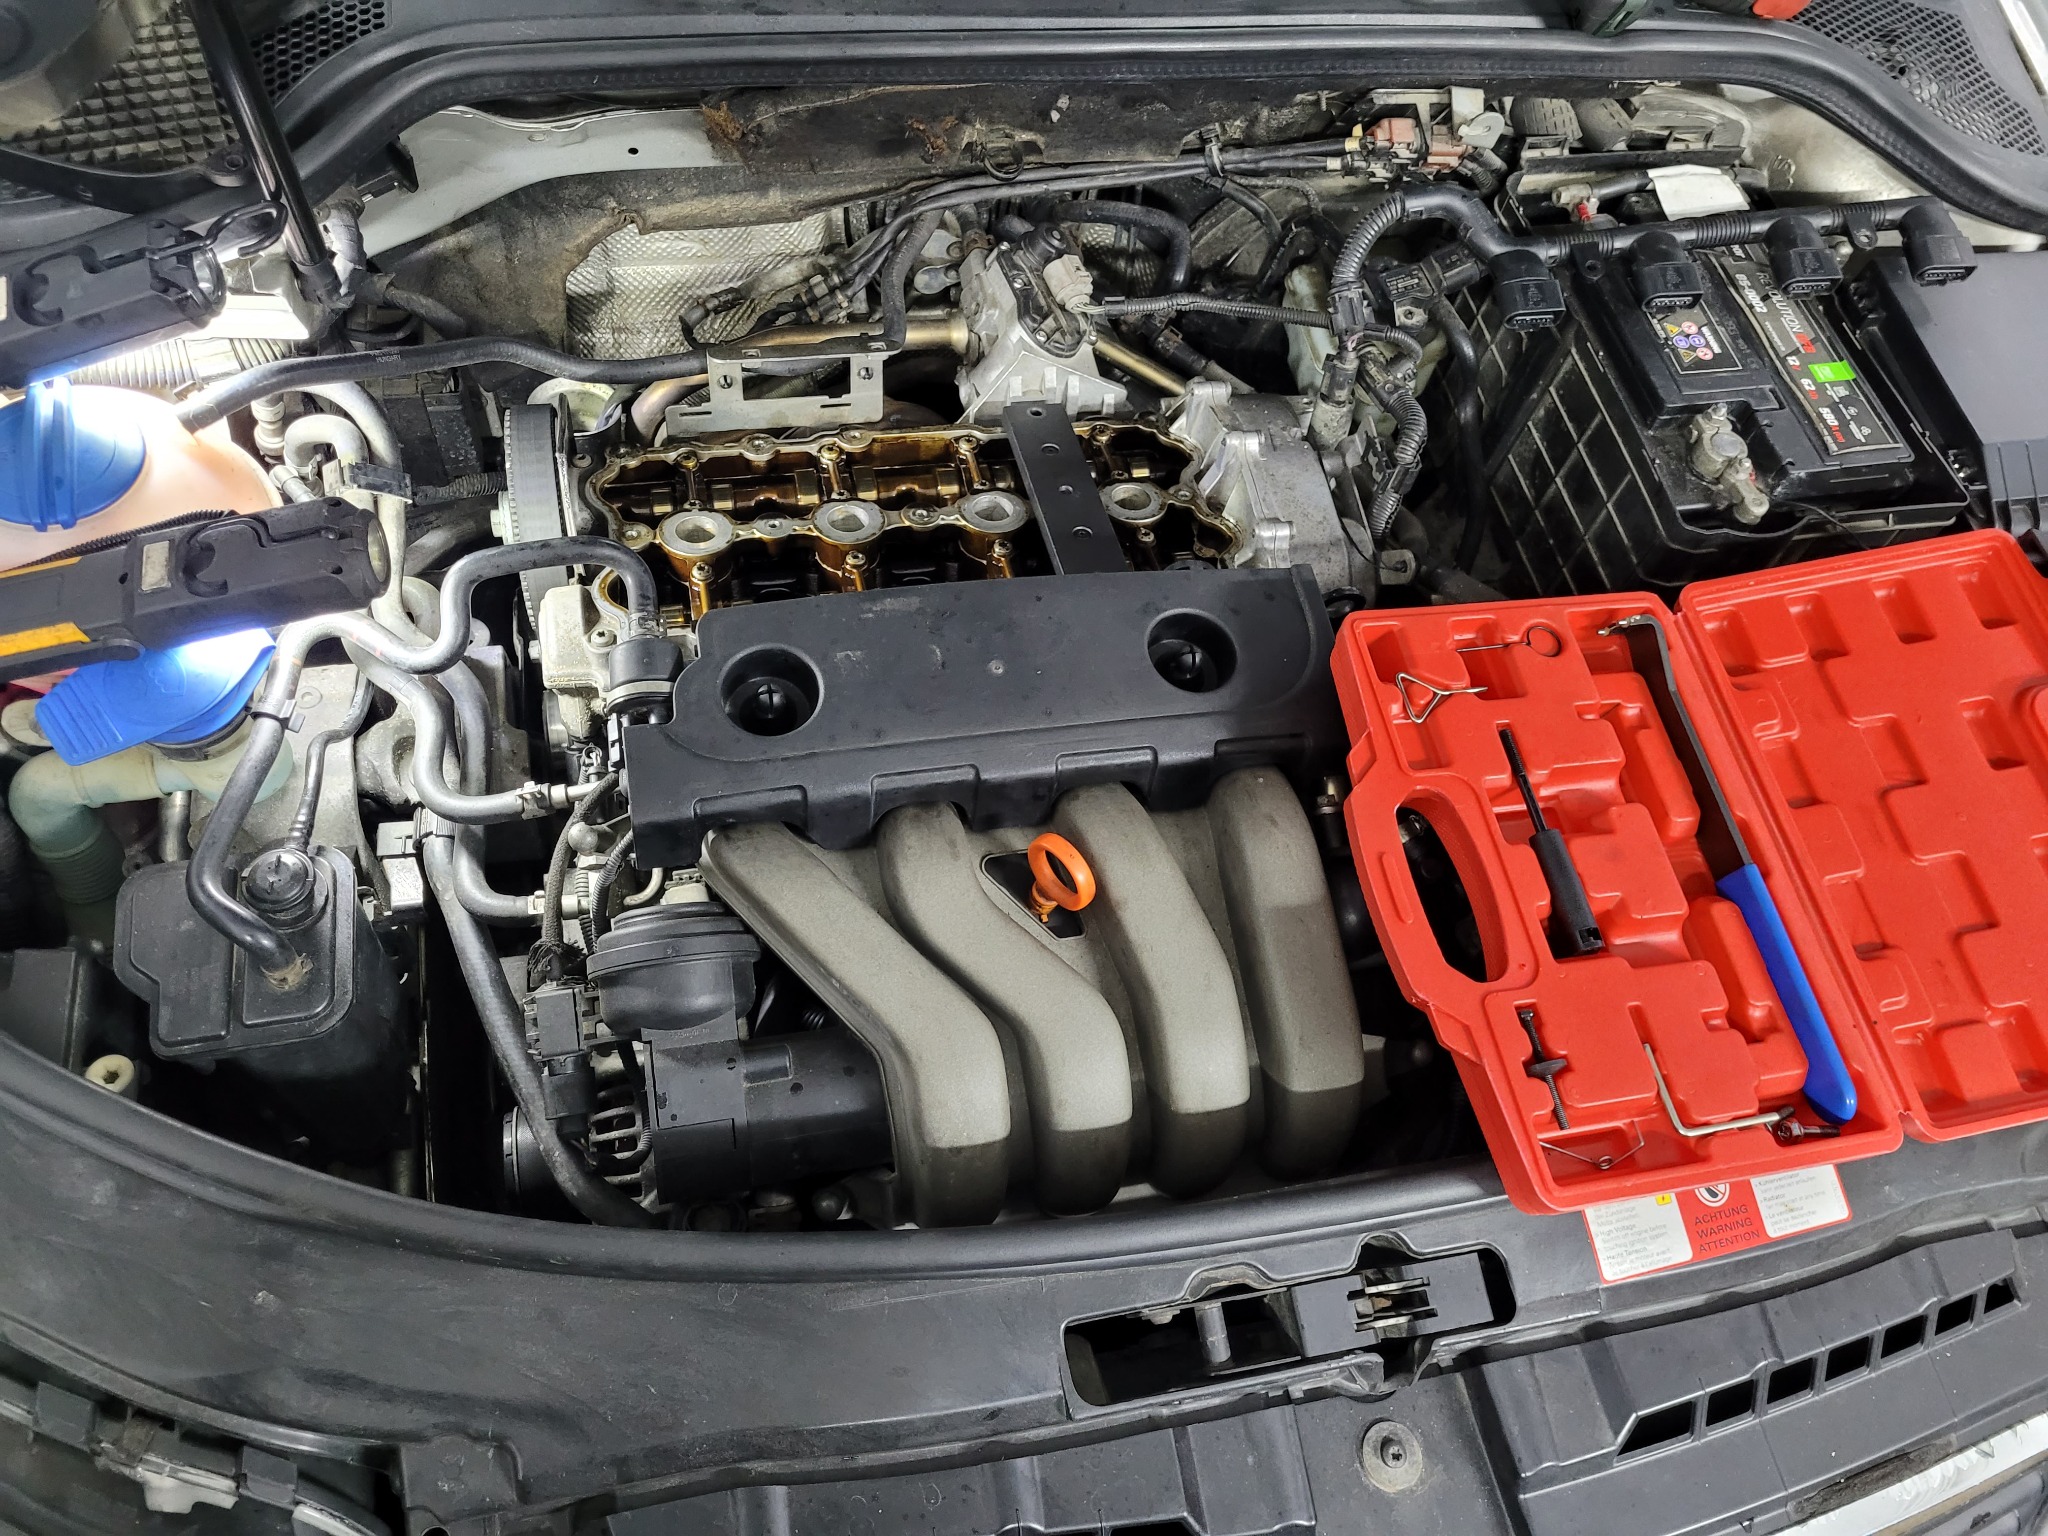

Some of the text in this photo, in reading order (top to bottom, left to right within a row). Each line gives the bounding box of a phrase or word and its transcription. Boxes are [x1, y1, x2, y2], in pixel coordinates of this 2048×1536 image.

[1756, 272, 1804, 333] REVOLUTION
[1694, 1204, 1749, 1226] ACHTUNG
[1696, 1217, 1753, 1239] WARNING
[1698, 1230, 1761, 1253] ATTENTION
